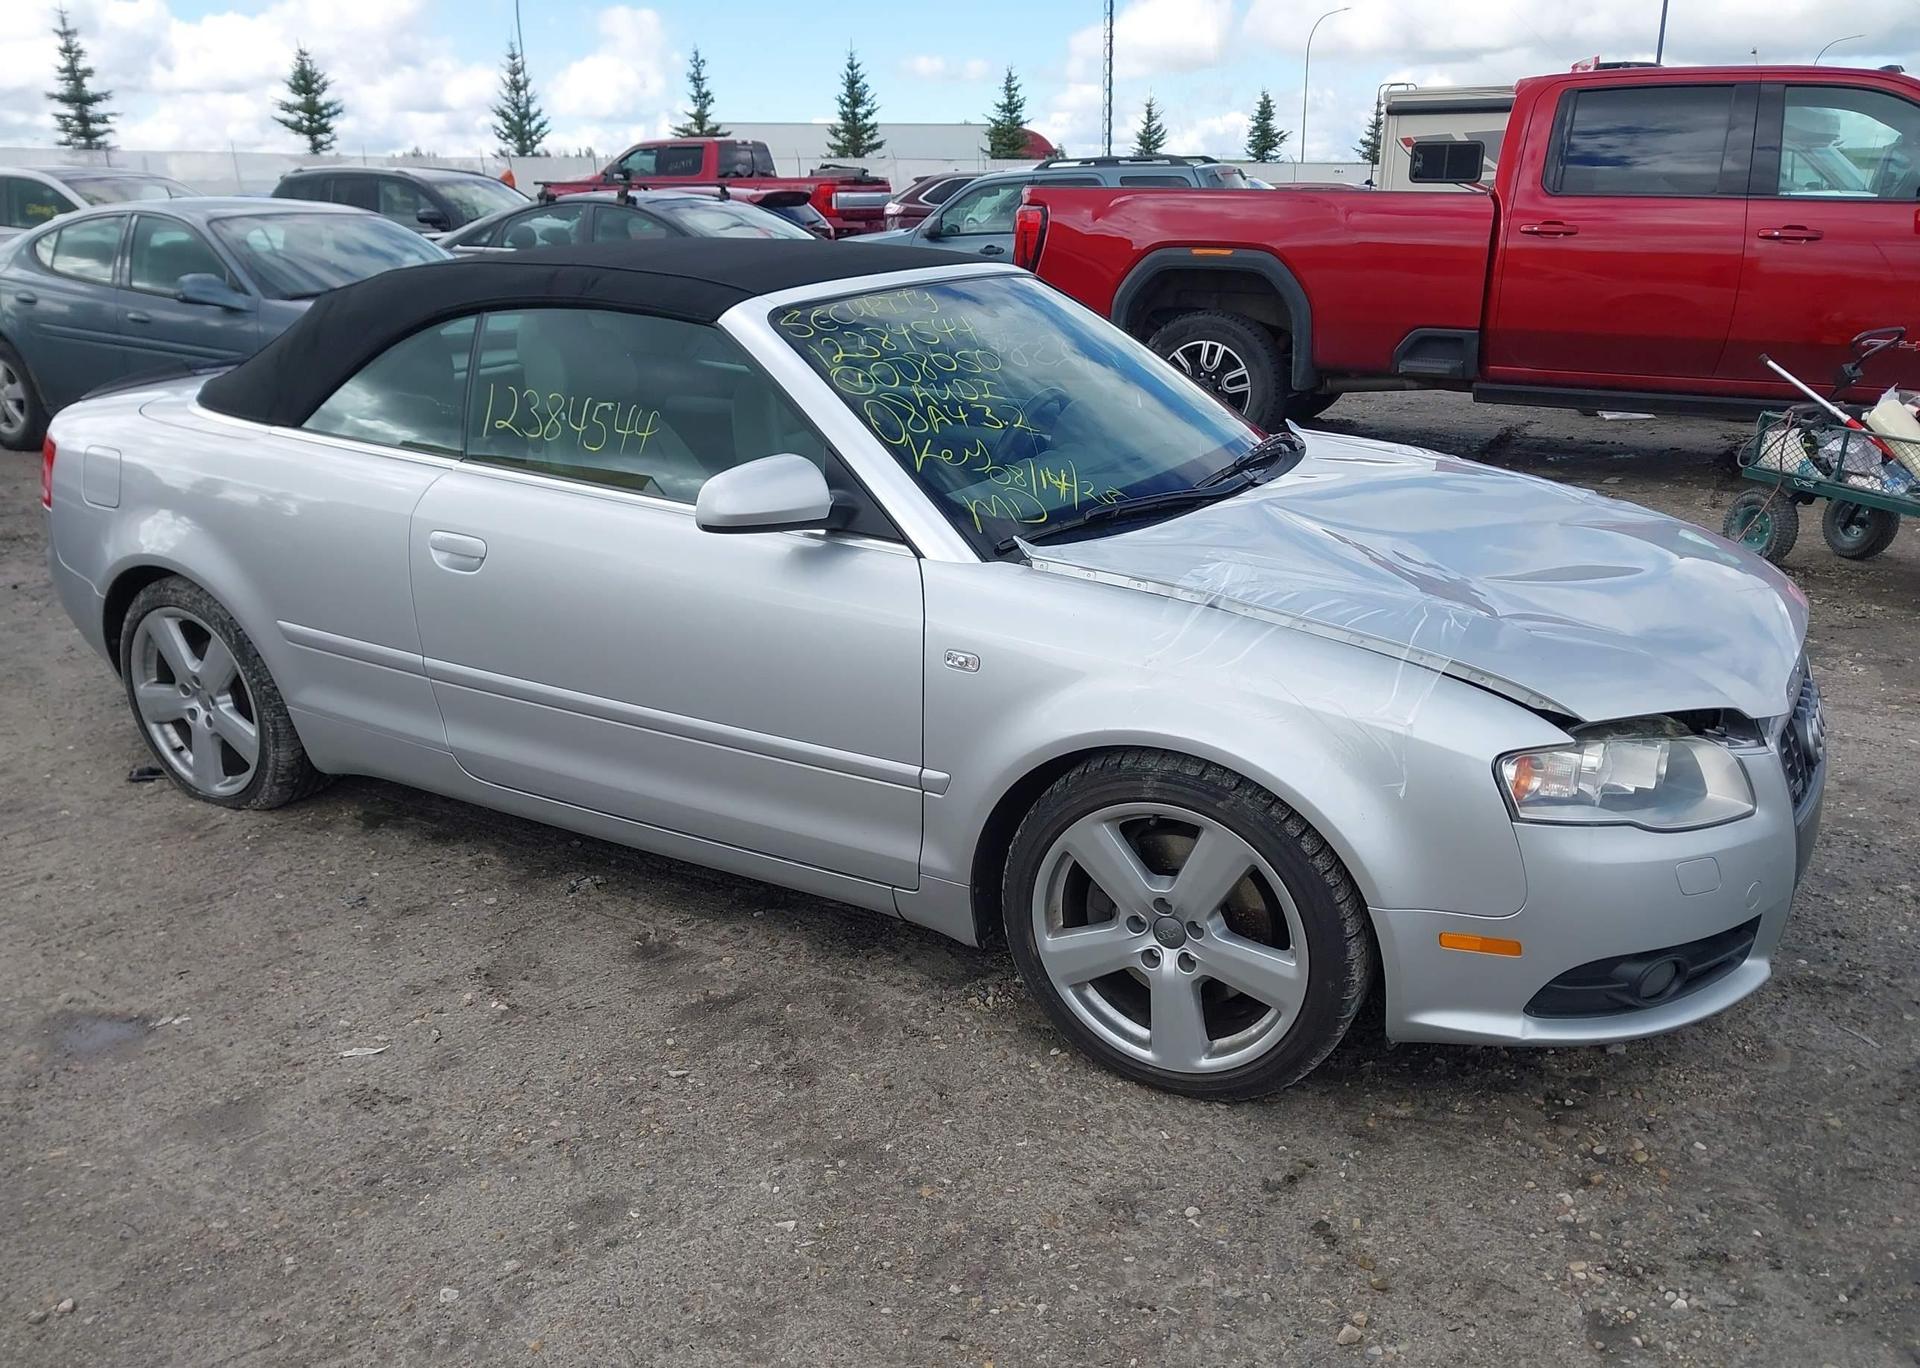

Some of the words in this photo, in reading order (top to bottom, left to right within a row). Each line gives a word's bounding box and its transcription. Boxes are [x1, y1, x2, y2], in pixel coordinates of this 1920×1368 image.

[808, 315, 978, 369] 12384544
[482, 383, 661, 455] 12384544
[910, 378, 1007, 407] AUDI
